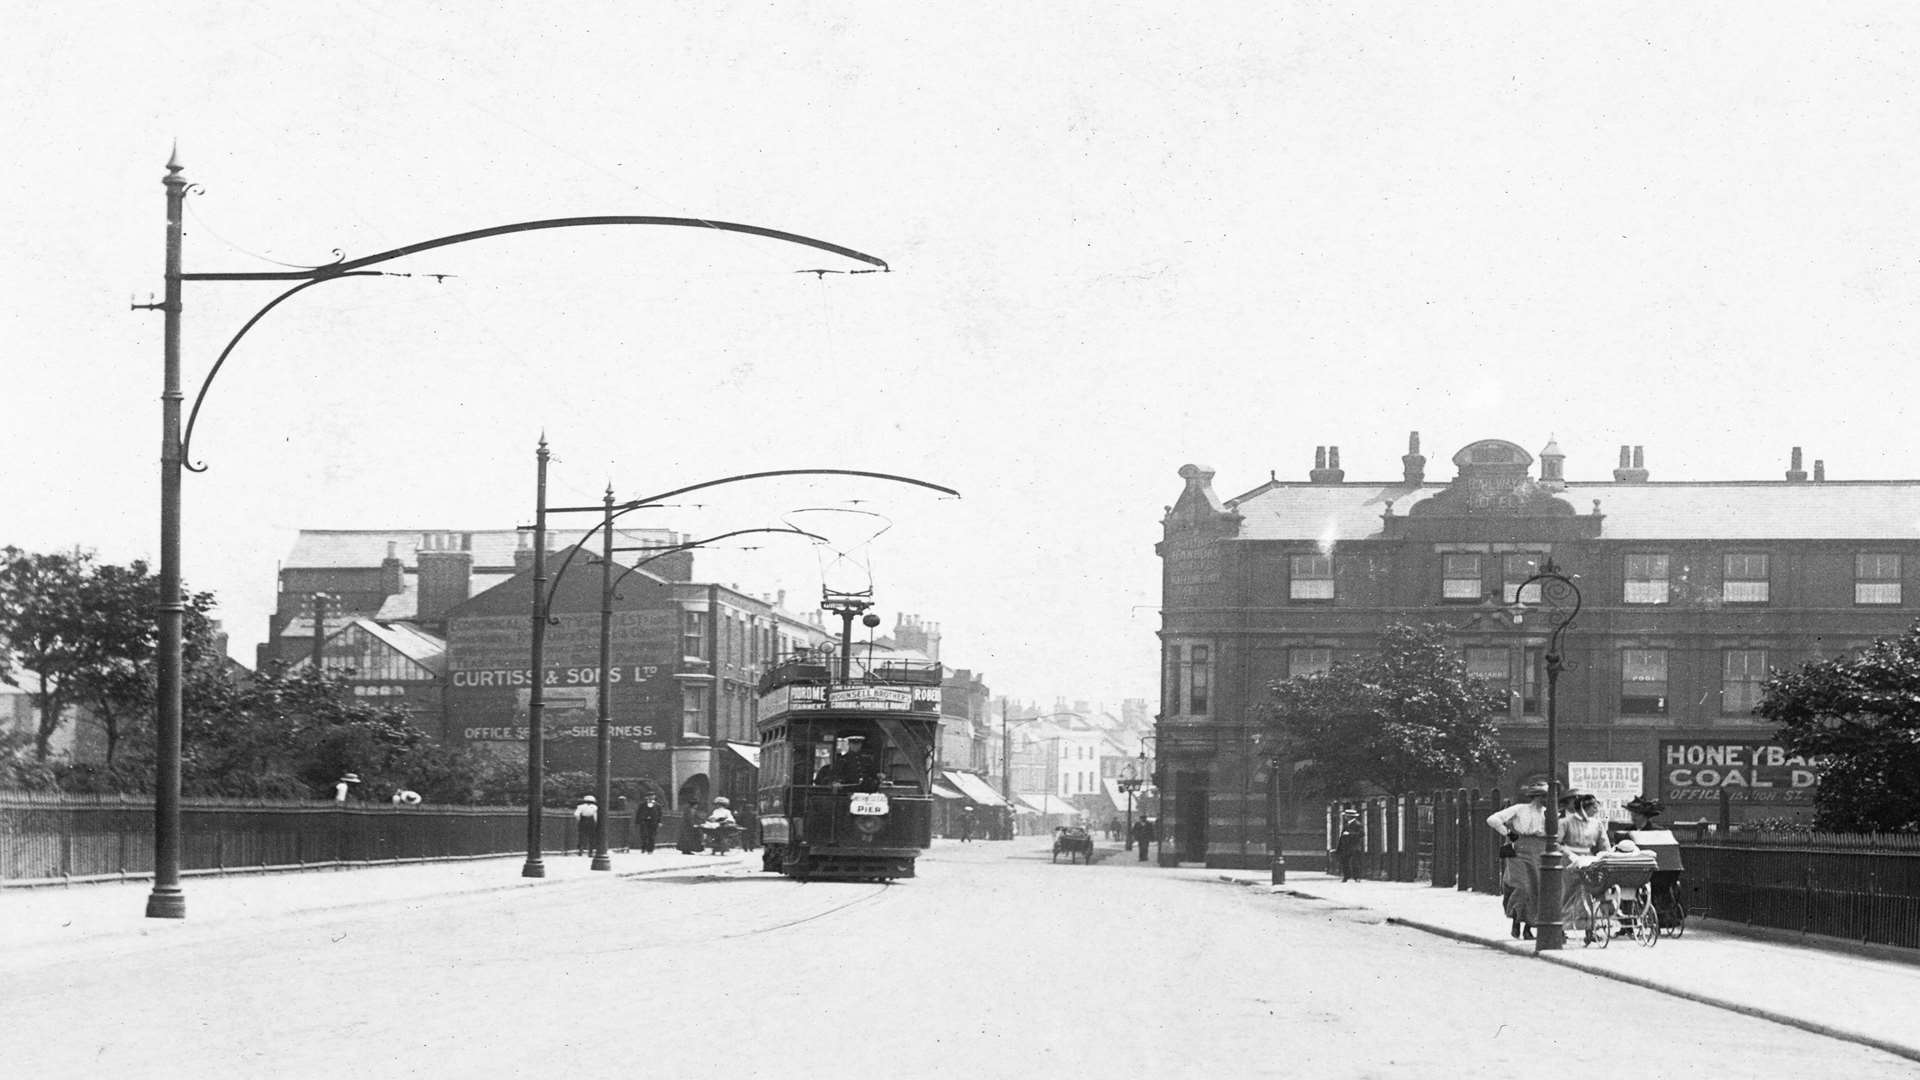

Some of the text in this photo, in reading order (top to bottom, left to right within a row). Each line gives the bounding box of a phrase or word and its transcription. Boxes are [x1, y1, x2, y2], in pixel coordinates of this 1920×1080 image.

[545, 670, 559, 685] &
[567, 668, 622, 684] SOS
[464, 727, 511, 739] OFFICE
[571, 725, 656, 738] SHERNESS.
[1572, 767, 1640, 783] ELECTRIC
[1669, 769, 1773, 787] COAL
[1586, 780, 1626, 789] THEATRE
[1670, 788, 1721, 801] OFFICE
[857, 805, 881, 813] PIER
